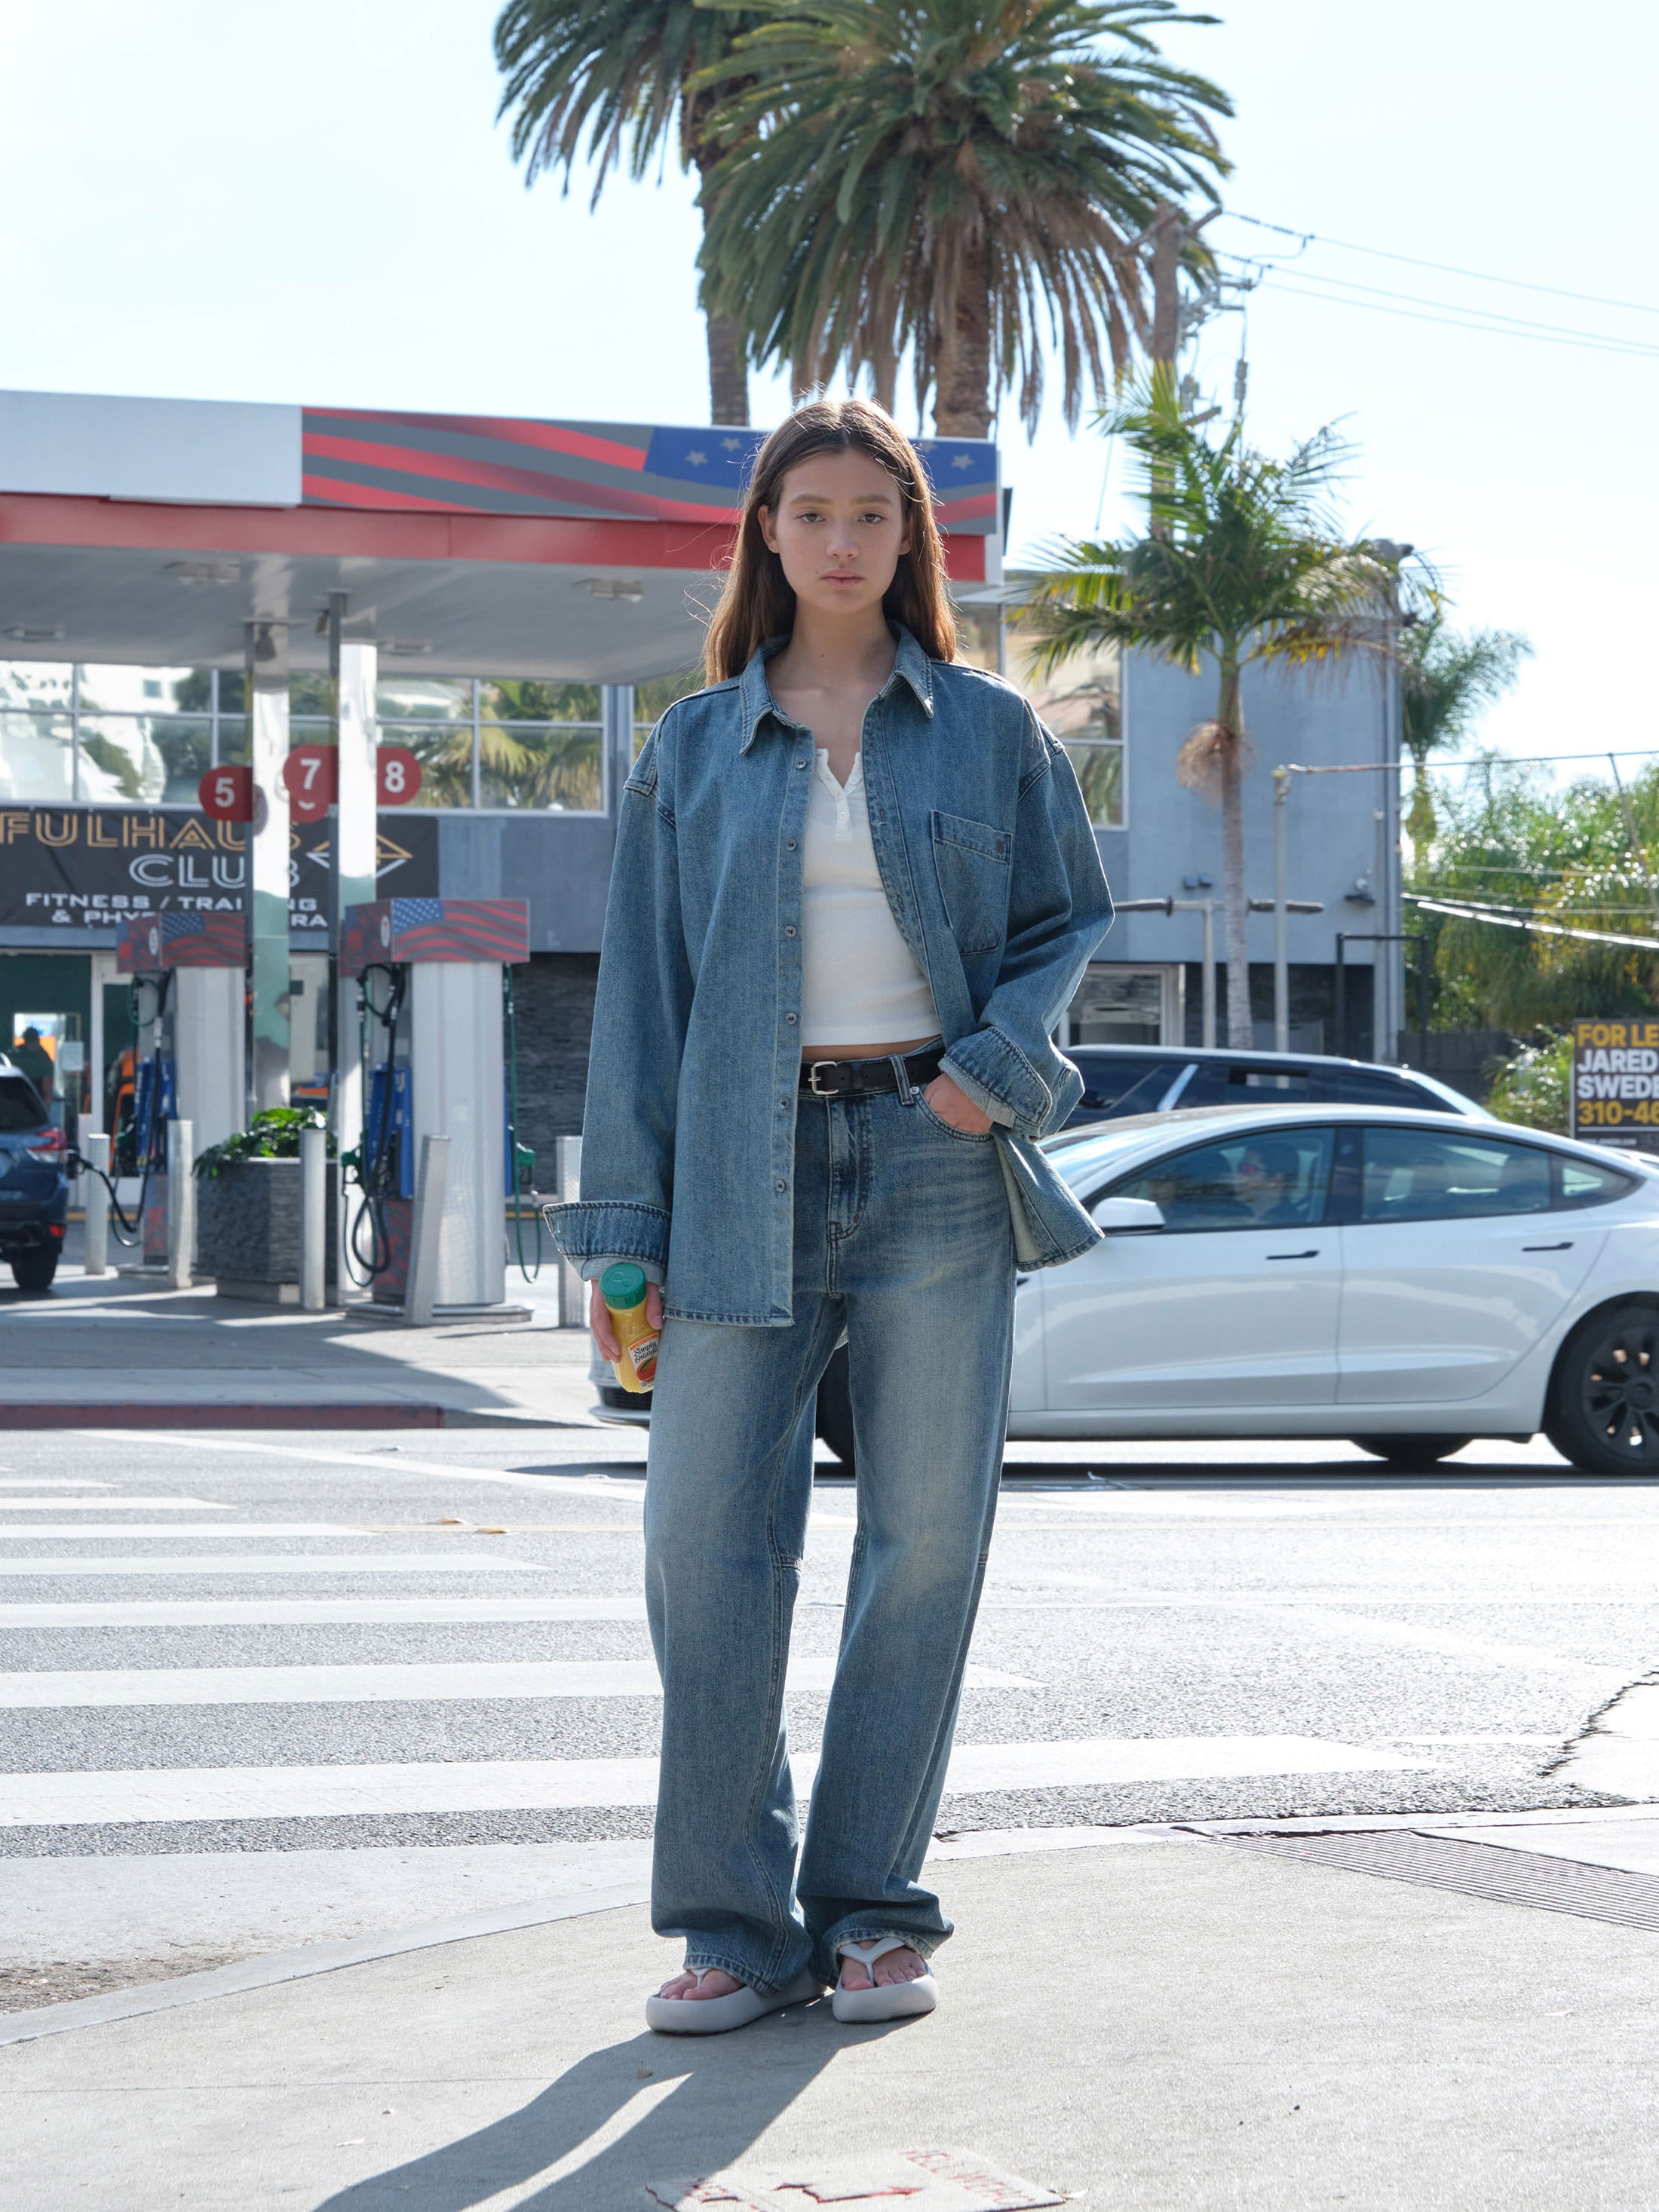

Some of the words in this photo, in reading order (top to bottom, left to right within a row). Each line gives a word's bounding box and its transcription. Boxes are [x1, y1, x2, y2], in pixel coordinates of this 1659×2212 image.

[300, 758, 320, 790] 7
[385, 761, 405, 793] 8
[215, 777, 235, 808] 5
[26, 893, 150, 909] FITNESS
[51, 909, 72, 924] &
[1577, 1024, 1627, 1047] FOR
[1577, 1049, 1659, 1073] JARED
